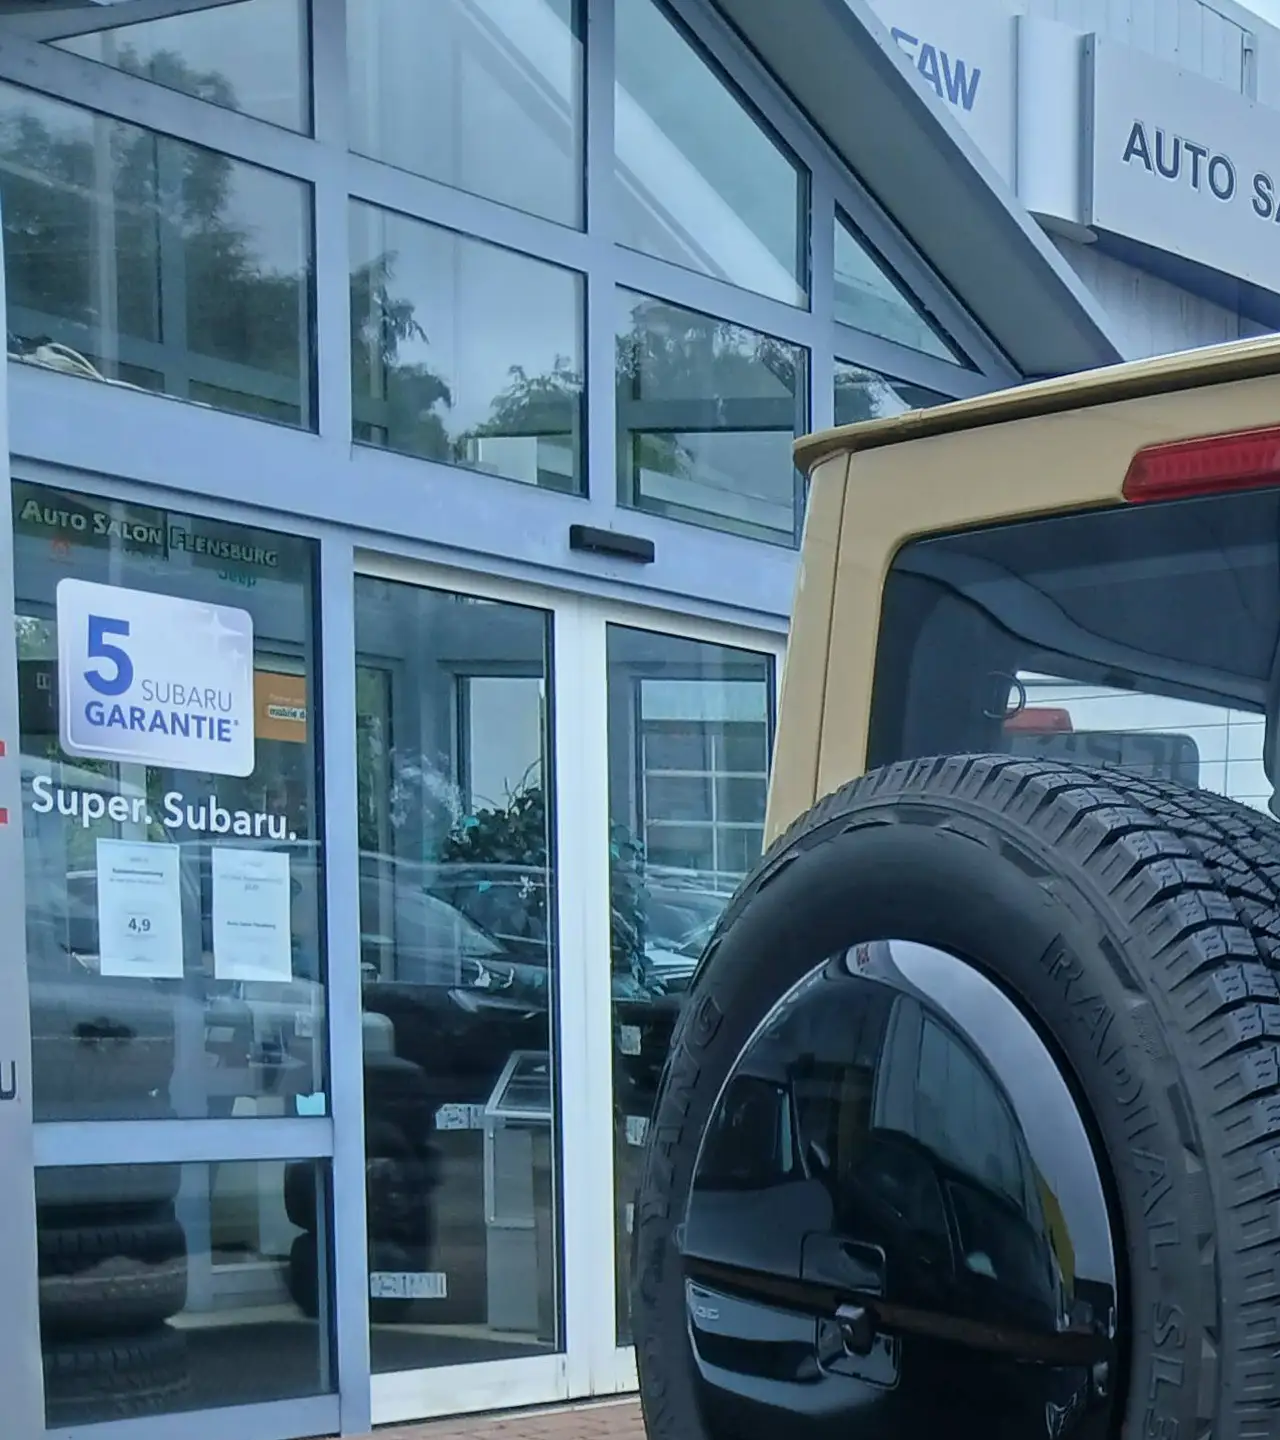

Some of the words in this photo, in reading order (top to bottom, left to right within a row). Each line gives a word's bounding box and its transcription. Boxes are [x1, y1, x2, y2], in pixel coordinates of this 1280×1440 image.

[1122, 120, 1238, 202] AUTO
[83, 614, 134, 696] 5
[141, 679, 233, 712] SUBARU
[31, 775, 153, 828] Super.
[164, 791, 297, 842] Subaru.
[128, 917, 151, 934] 4,9
